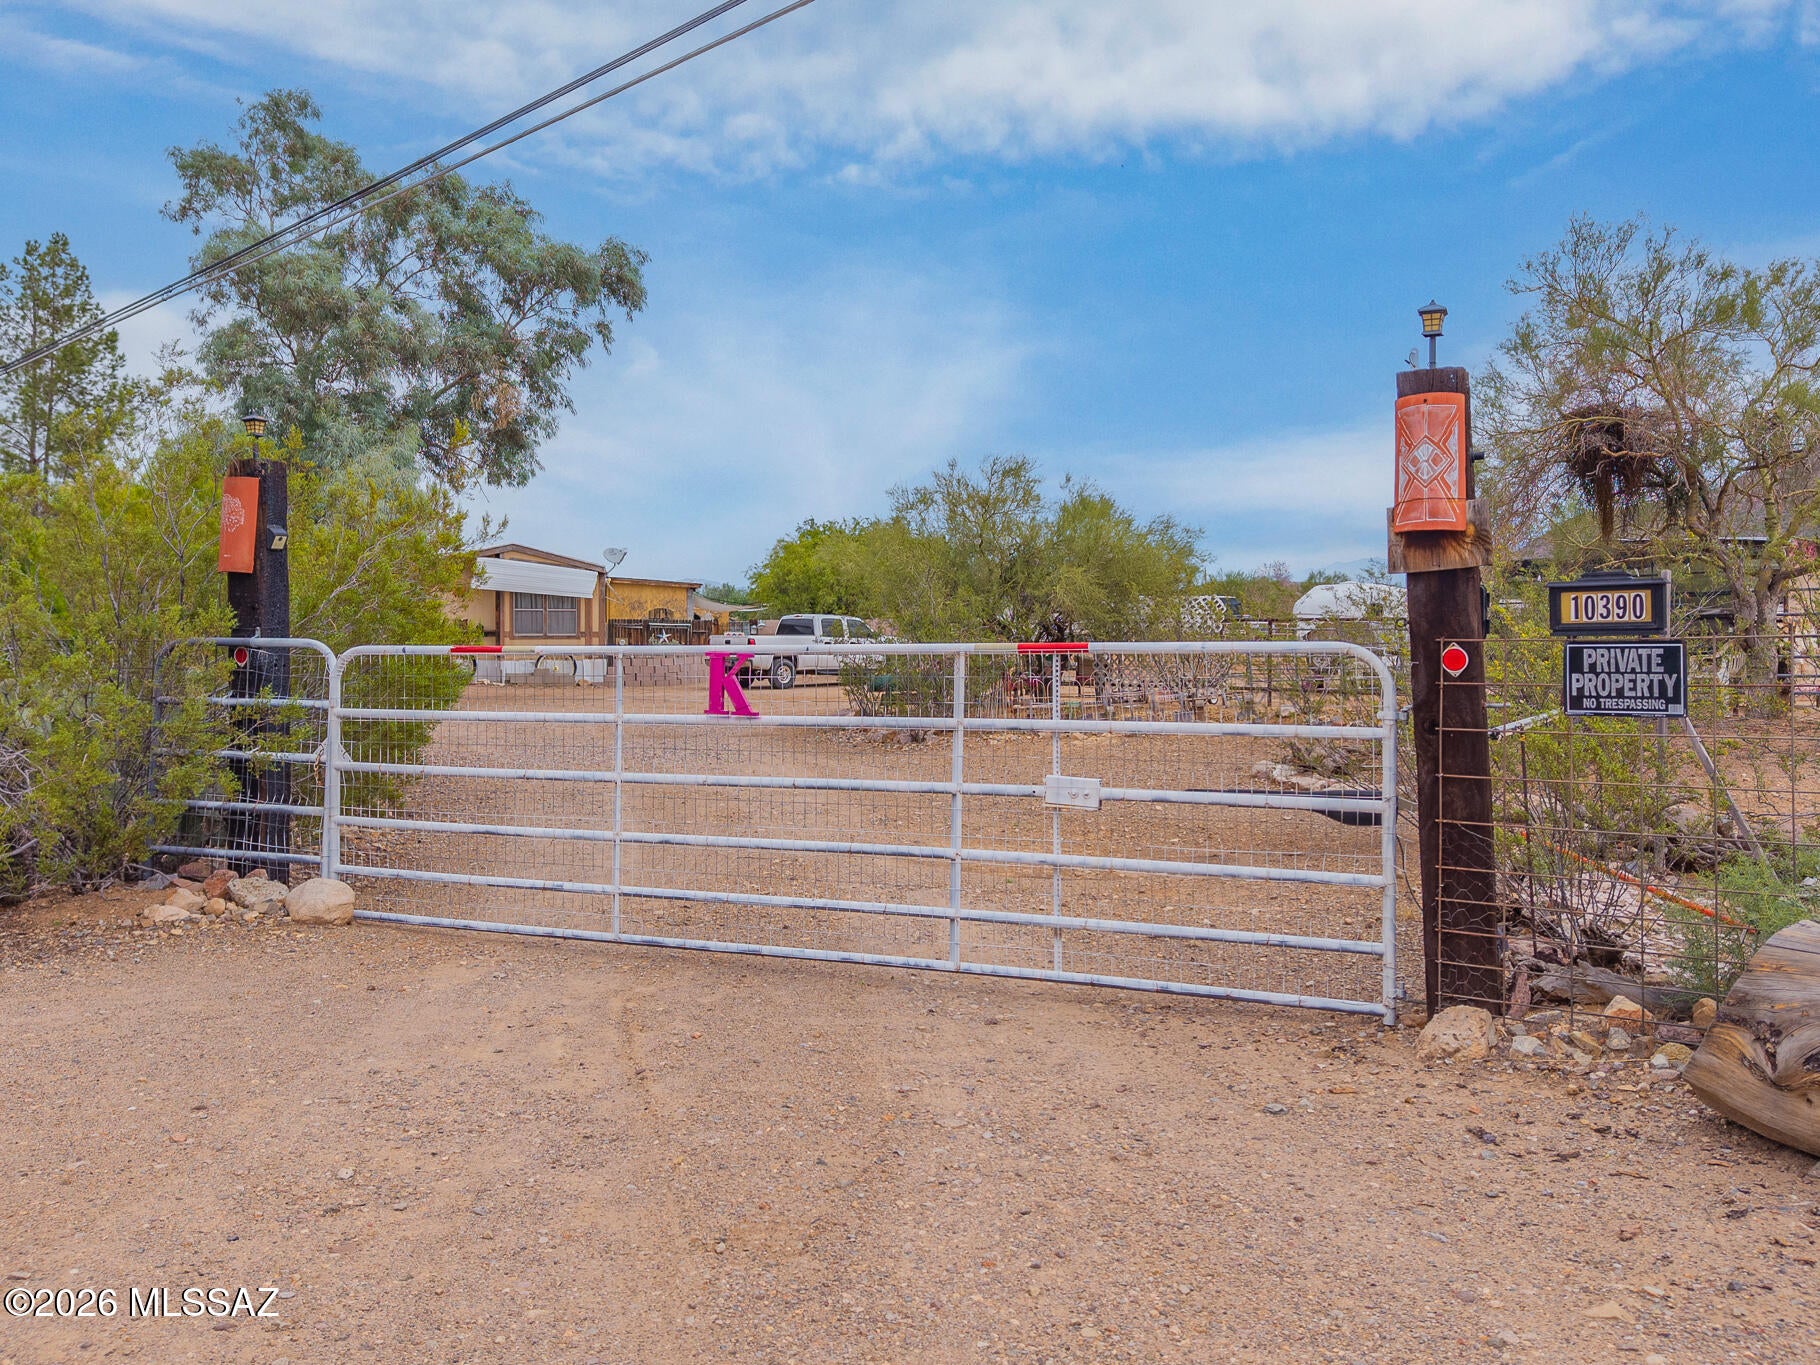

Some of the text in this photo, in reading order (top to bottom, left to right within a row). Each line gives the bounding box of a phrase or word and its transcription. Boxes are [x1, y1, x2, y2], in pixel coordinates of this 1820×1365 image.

[1571, 593, 1646, 620] 10390
[1583, 648, 1664, 673] PRIVATE
[704, 652, 760, 717] K
[1571, 673, 1678, 697] PROPERTY
[1583, 698, 1666, 710] NO TRESPASSING
